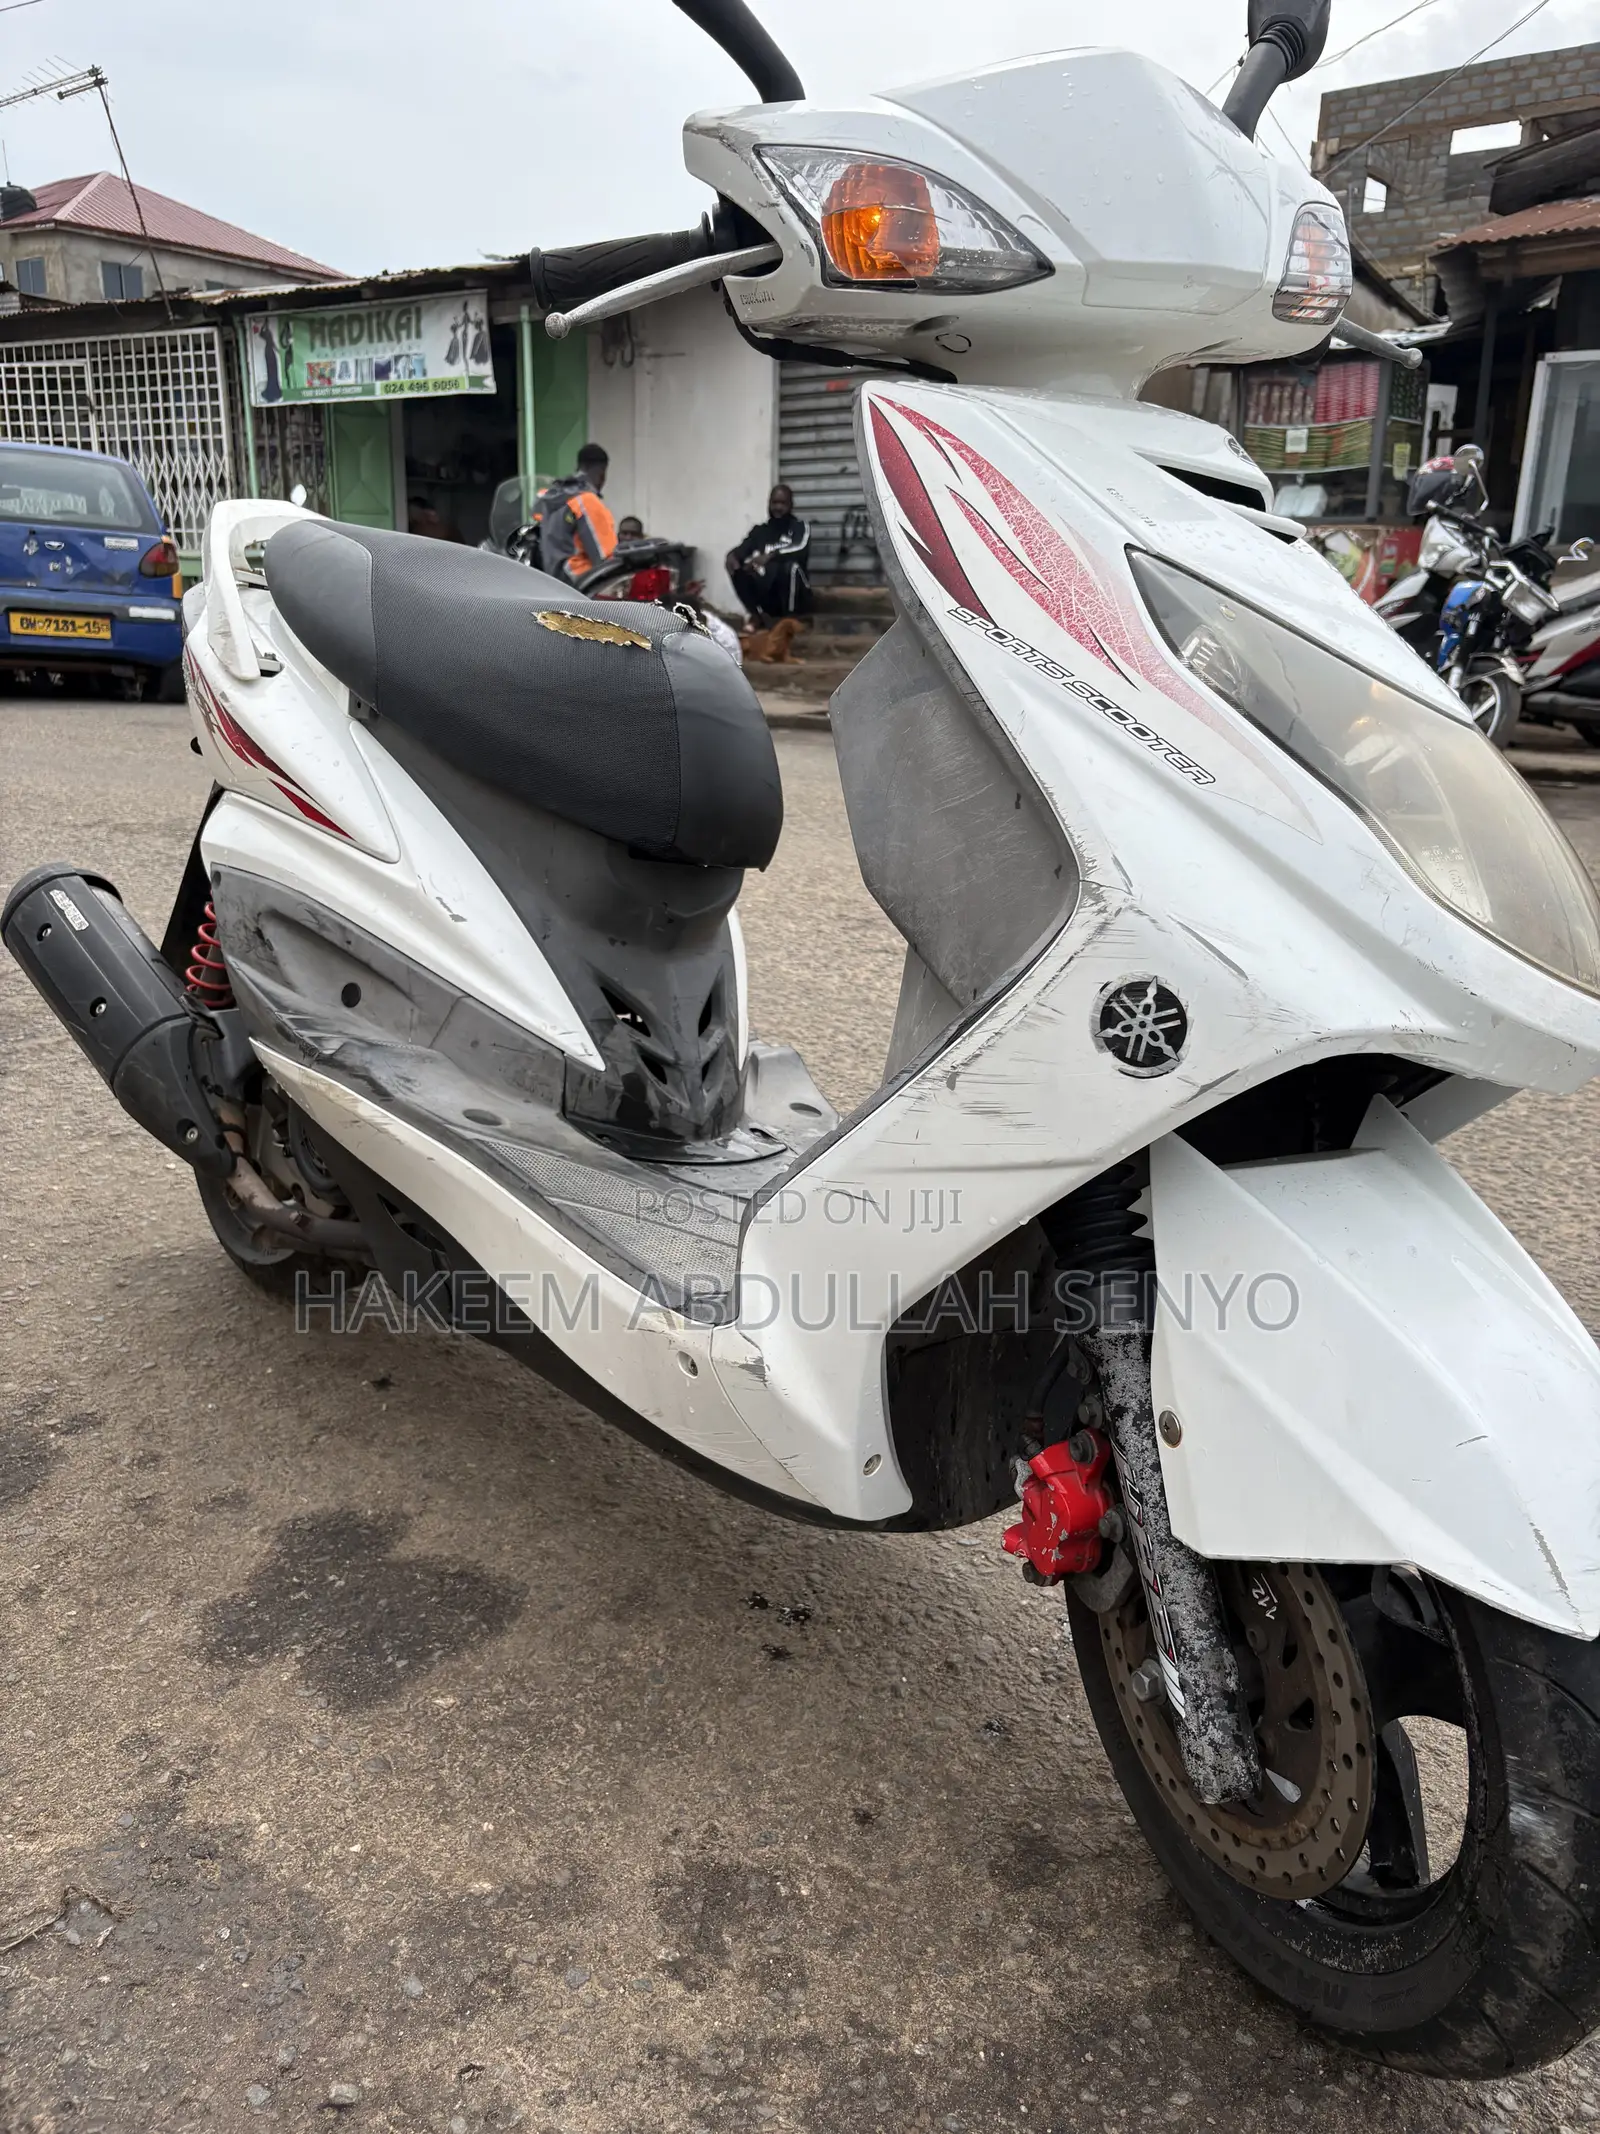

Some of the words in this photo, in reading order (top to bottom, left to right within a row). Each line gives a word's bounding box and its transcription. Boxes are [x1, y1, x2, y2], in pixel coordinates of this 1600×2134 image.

[383, 382, 405, 394] 024
[945, 606, 1075, 680] SPORTS
[1063, 680, 1216, 785] SCOOTER
